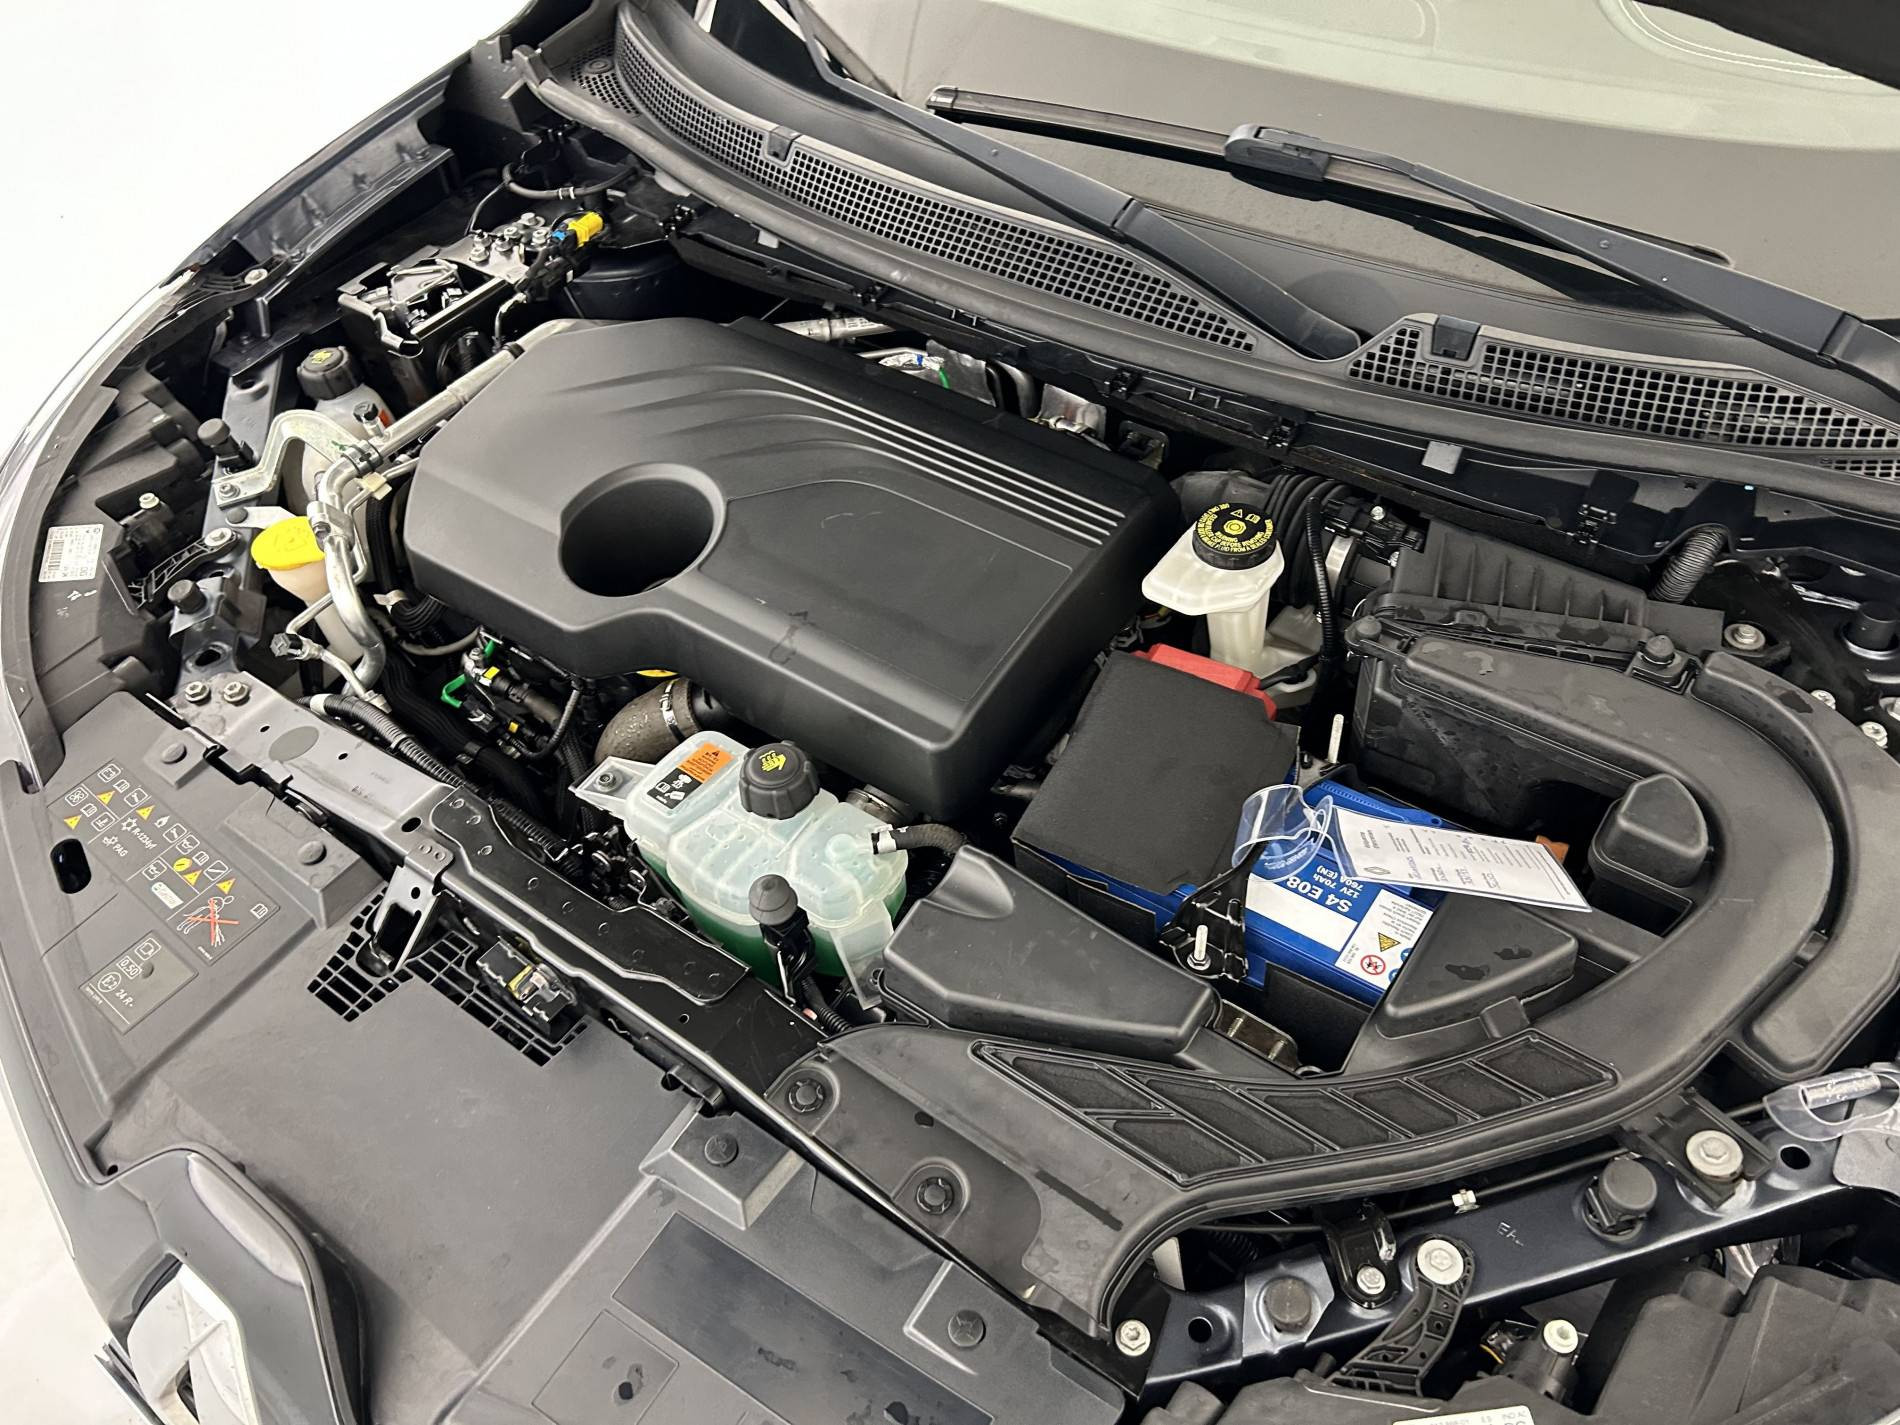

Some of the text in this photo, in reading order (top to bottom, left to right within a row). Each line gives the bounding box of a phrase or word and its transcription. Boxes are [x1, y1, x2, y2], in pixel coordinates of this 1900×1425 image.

[1219, 540, 1242, 548] BEFORE
[112, 844, 128, 857] PAG
[1312, 873, 1361, 899] 12V 70Ah
[1316, 865, 1364, 892] 760A (EN)
[1286, 875, 1353, 912] S4 E08
[120, 959, 139, 976] 0,50
